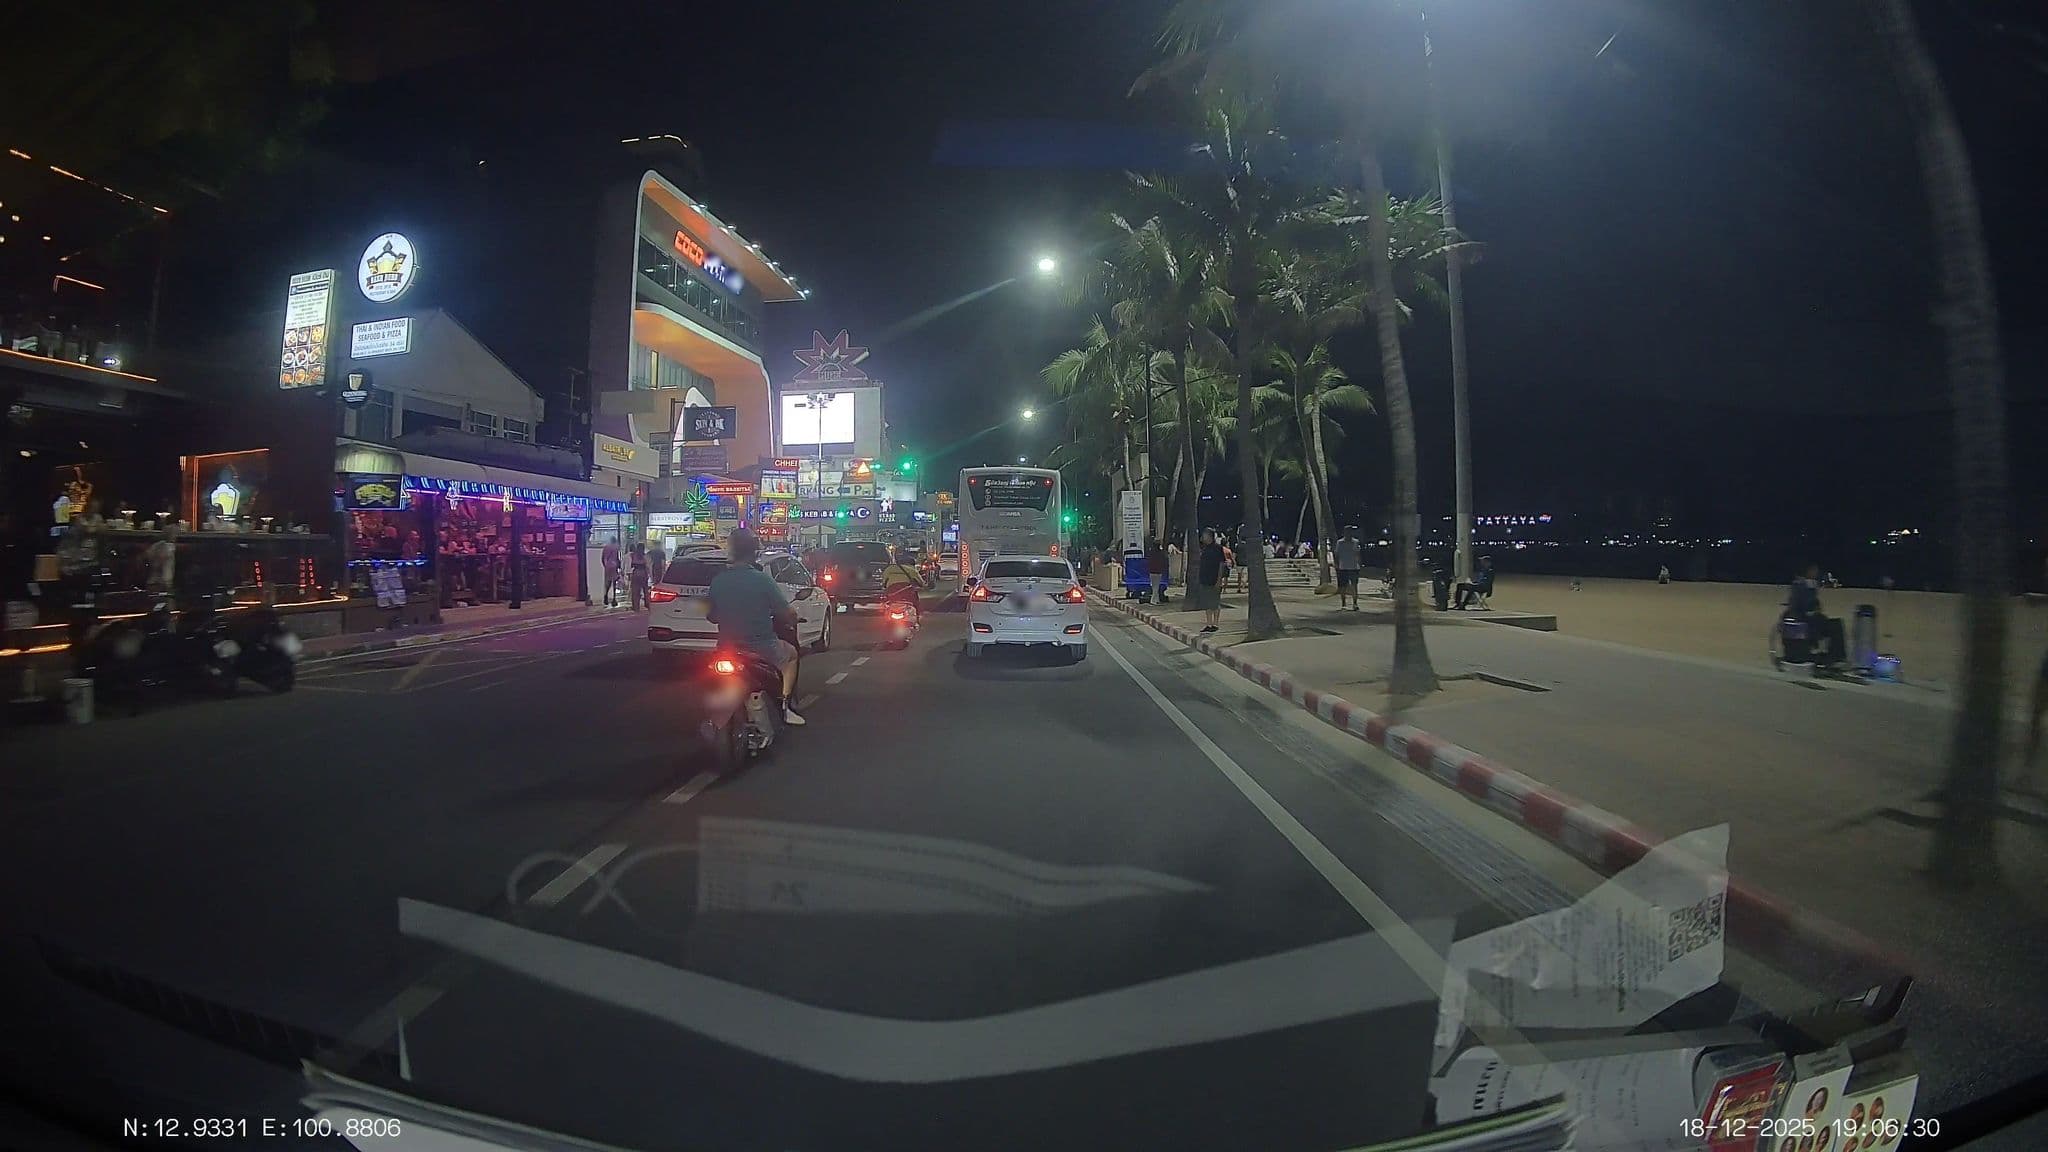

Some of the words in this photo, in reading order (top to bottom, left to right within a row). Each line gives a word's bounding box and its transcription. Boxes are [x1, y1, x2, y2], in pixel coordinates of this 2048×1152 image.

[675, 231, 704, 266] COCO
[356, 324, 367, 333] THAI
[373, 321, 391, 331] INDIAN
[391, 319, 406, 329] FOOD
[358, 332, 381, 342] SEAFOOD
[387, 329, 401, 338] PIZZA
[1477, 515, 1536, 525] PATTAYA
